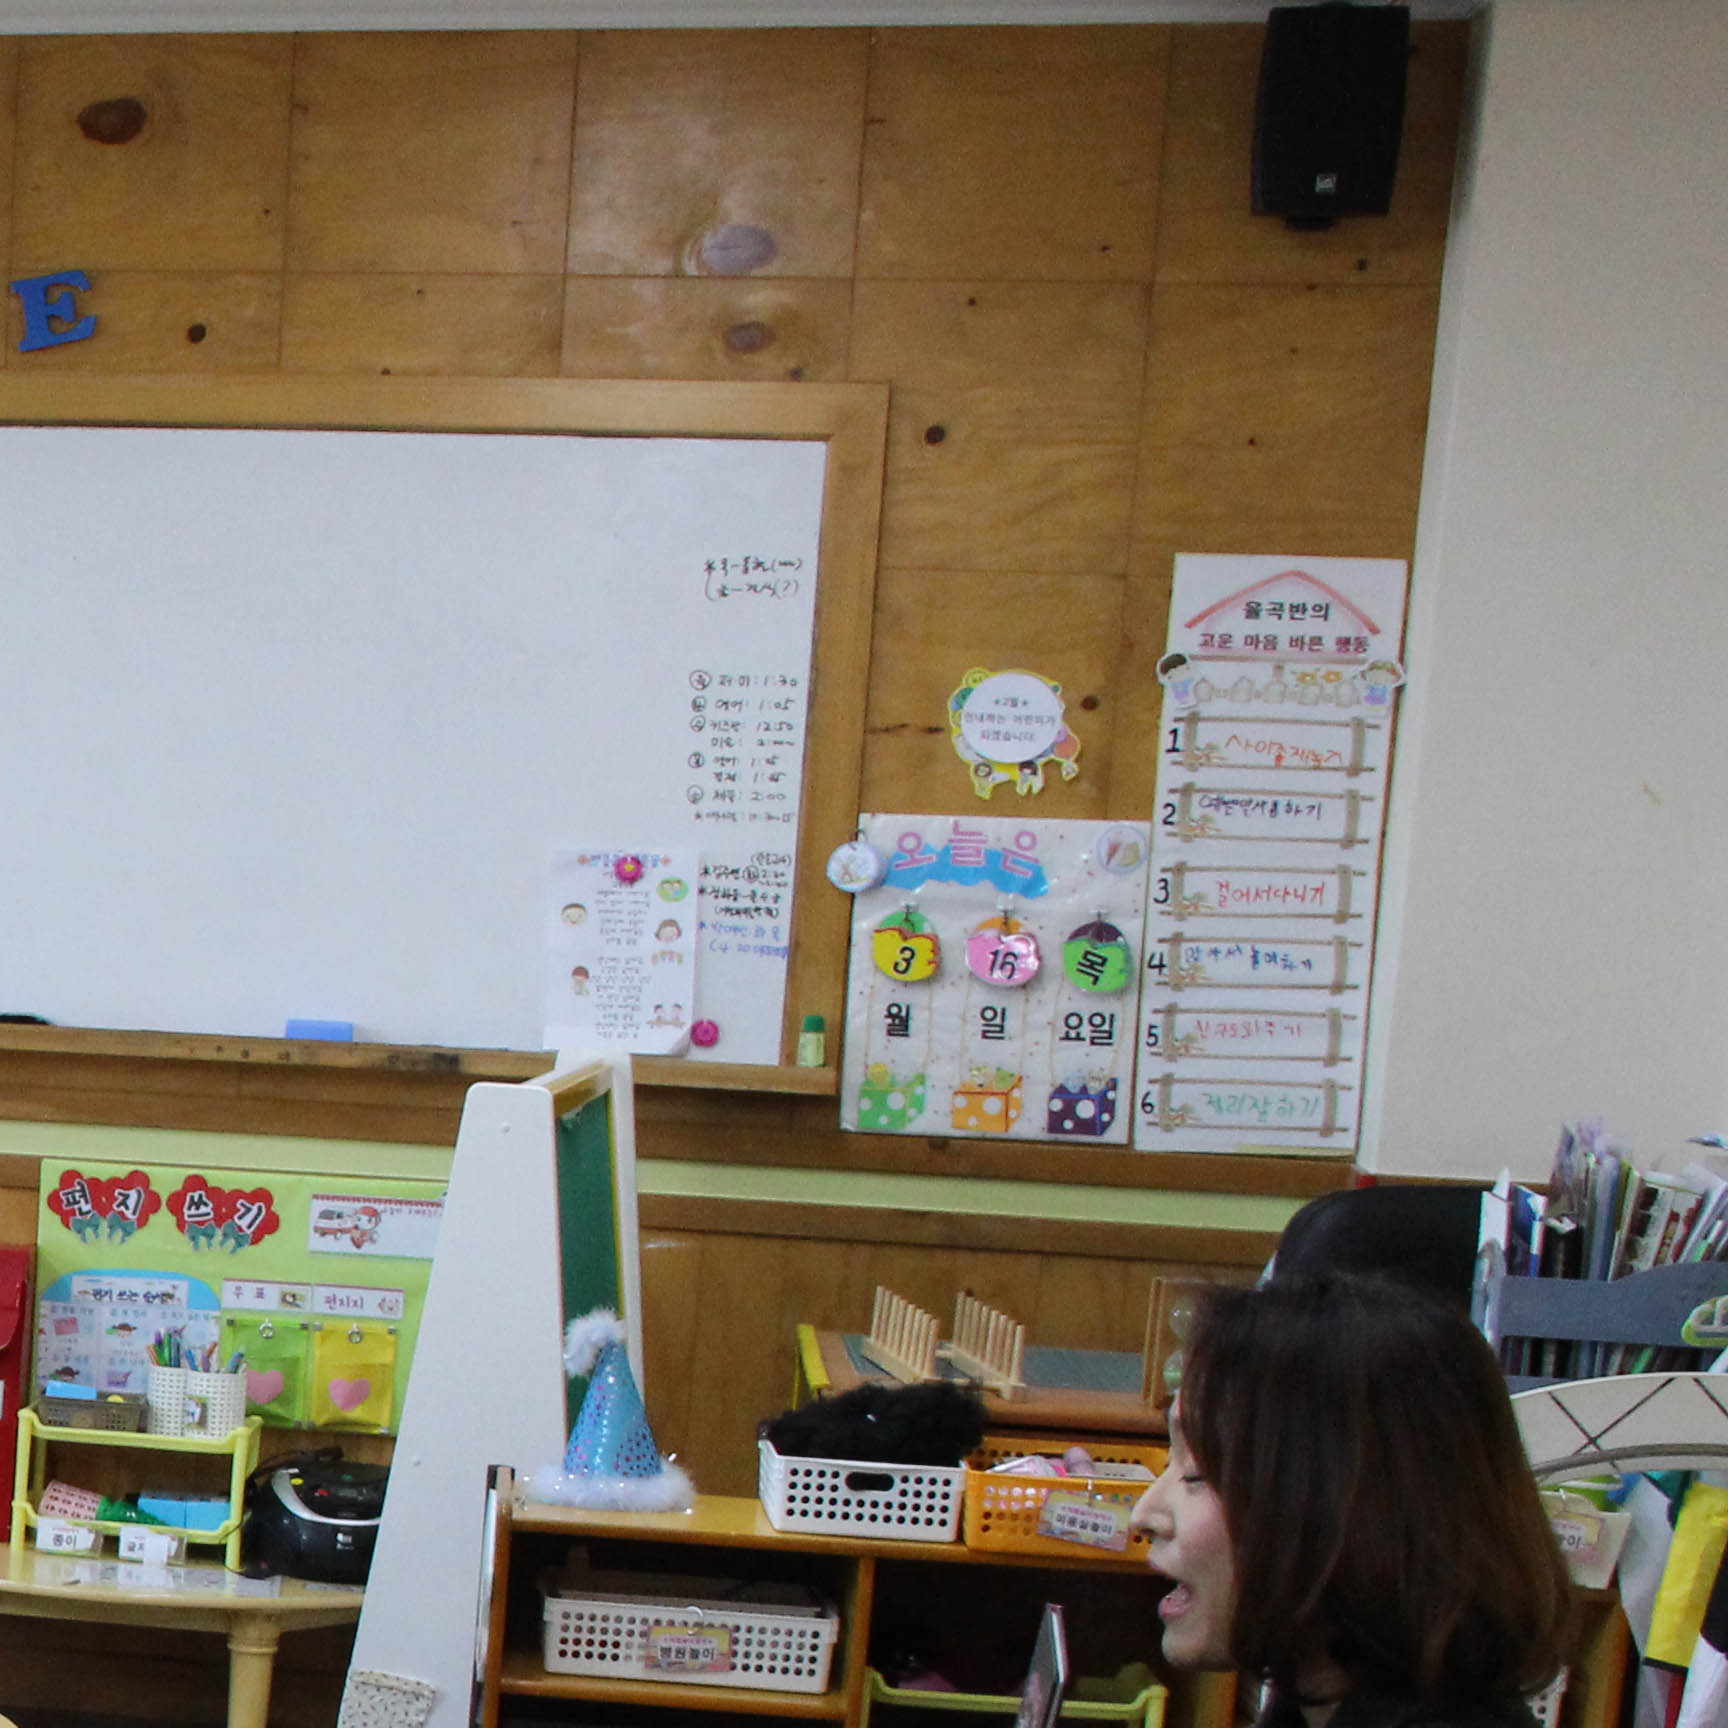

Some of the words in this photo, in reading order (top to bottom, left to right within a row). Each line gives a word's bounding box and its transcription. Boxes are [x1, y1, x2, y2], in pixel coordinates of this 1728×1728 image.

[1243, 600, 1330, 622] 율곡반의
[1198, 632, 1234, 650] 고운
[1243, 633, 1279, 651] 마음
[1288, 634, 1324, 652] 바른
[1334, 635, 1371, 654] 행동
[1164, 727, 1181, 753] 1
[1162, 802, 1177, 826] 2
[894, 820, 1041, 877] 오늘은
[1153, 877, 1170, 904] 3
[894, 946, 916, 976] 3
[988, 948, 1019, 980] 16
[1075, 947, 1108, 986] 목
[1147, 952, 1166, 970] 4
[884, 1002, 911, 1039] 월
[980, 1005, 1006, 1041] 일
[1059, 1011, 1115, 1047] 요일
[1146, 1024, 1159, 1047] 5
[1141, 1092, 1155, 1113] 6
[60, 1178, 144, 1218] 편지
[184, 1191, 266, 1233] 쓰기
[323, 1293, 364, 1311] 편지지
